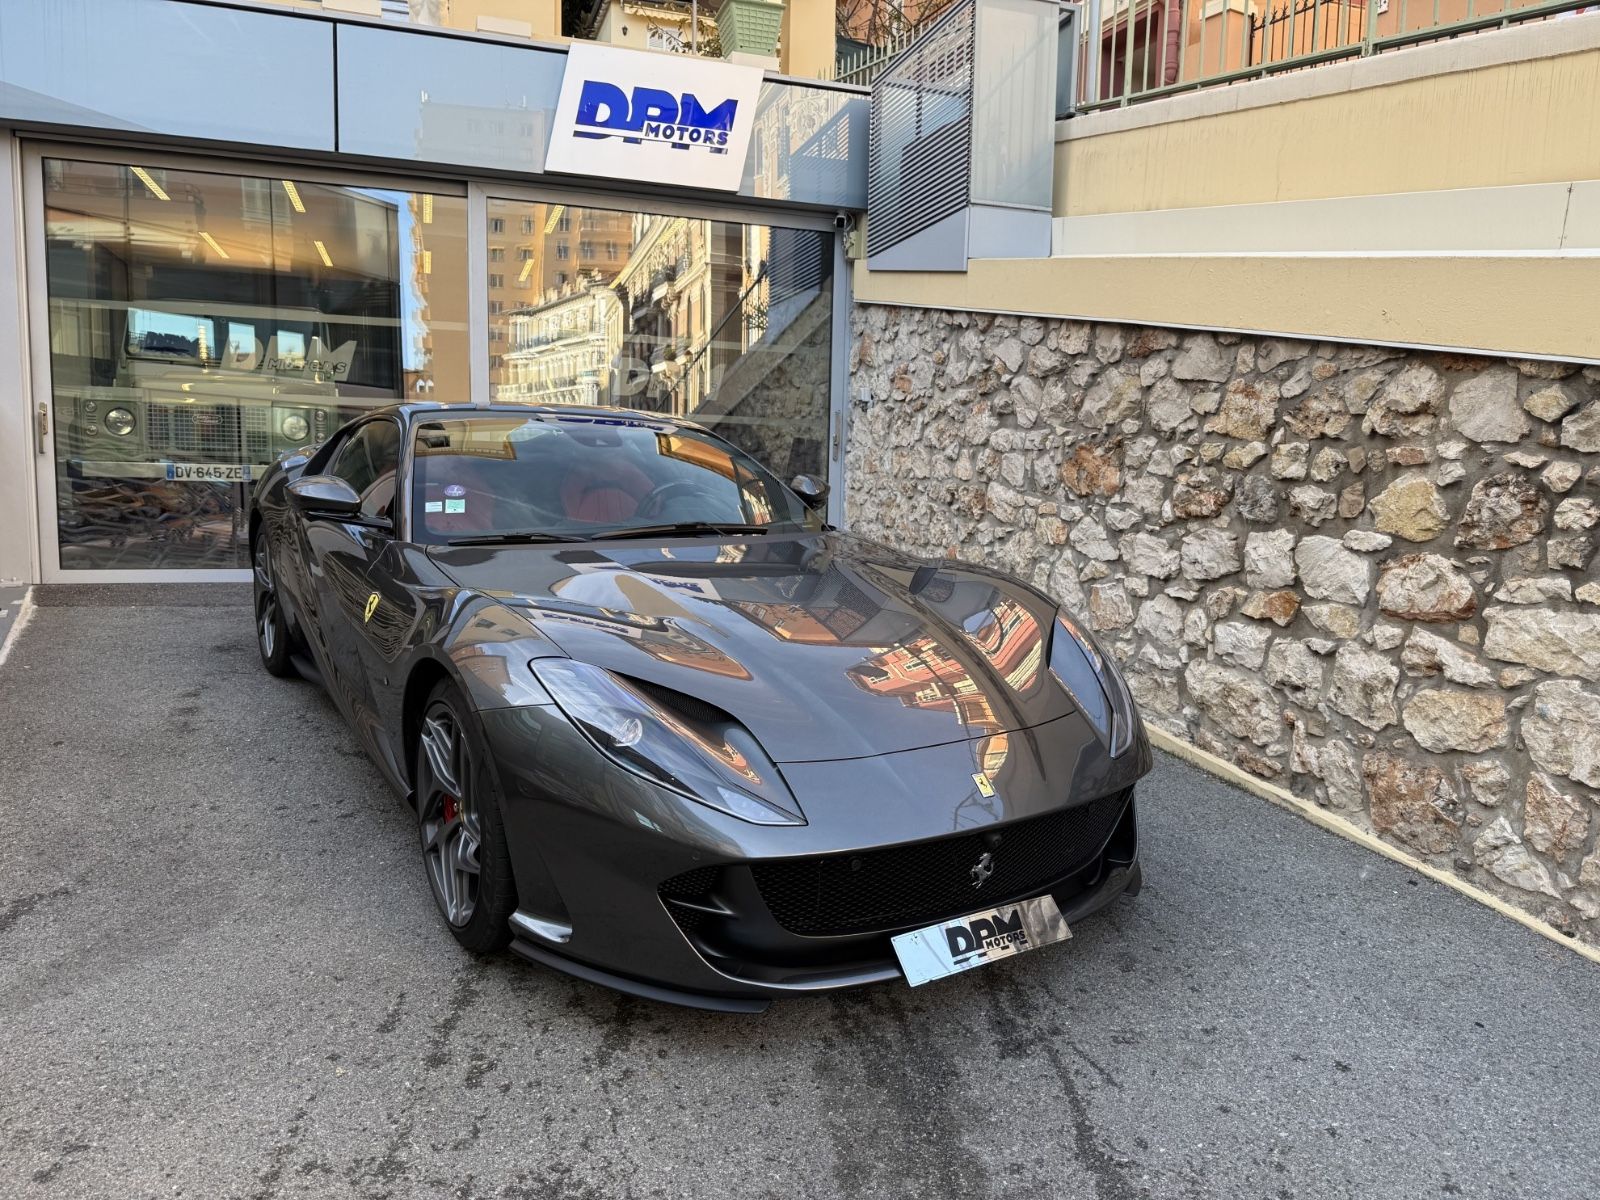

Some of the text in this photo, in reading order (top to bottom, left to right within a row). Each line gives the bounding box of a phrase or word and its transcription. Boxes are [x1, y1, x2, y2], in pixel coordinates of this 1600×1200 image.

[573, 80, 738, 154] DPM
[644, 122, 729, 146] MOTORS
[945, 909, 1027, 965] DPM
[985, 930, 1026, 950] MOTORS
